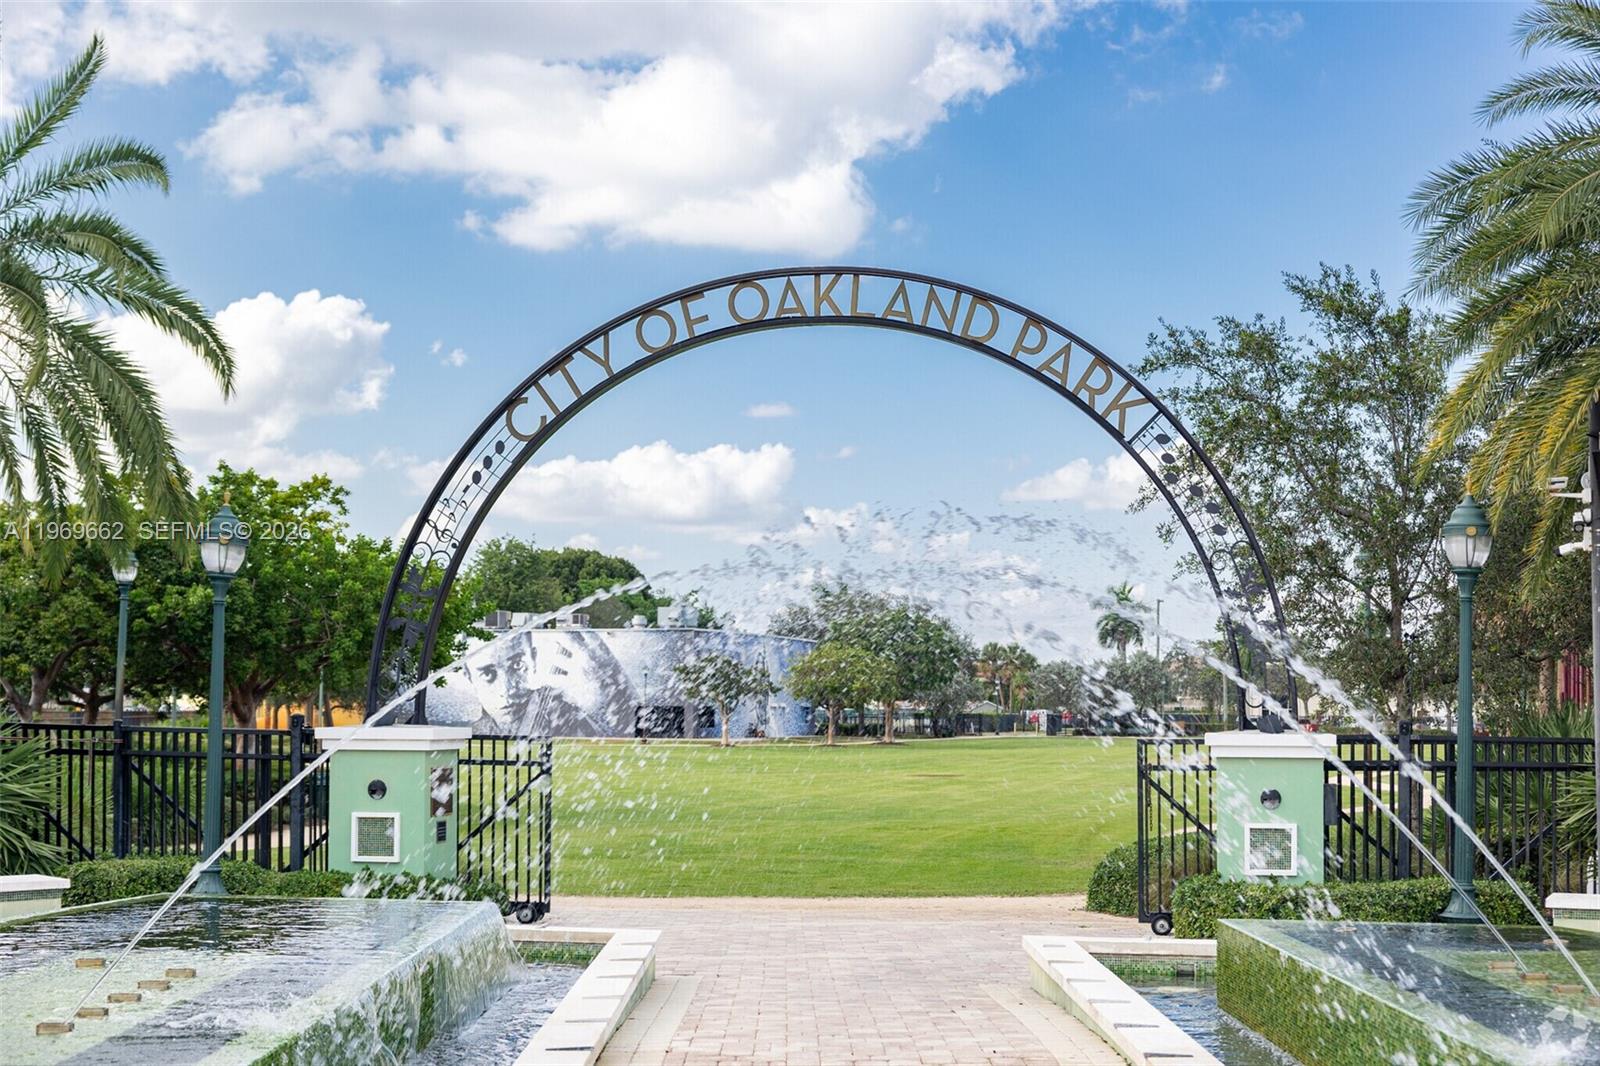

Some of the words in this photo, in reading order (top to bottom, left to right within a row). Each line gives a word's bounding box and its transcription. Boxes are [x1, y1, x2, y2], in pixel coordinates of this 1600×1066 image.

[505, 332, 614, 442] CITY
[635, 292, 709, 354] OF
[728, 273, 1000, 343] OAKLAND
[1010, 317, 1151, 437] PARK
